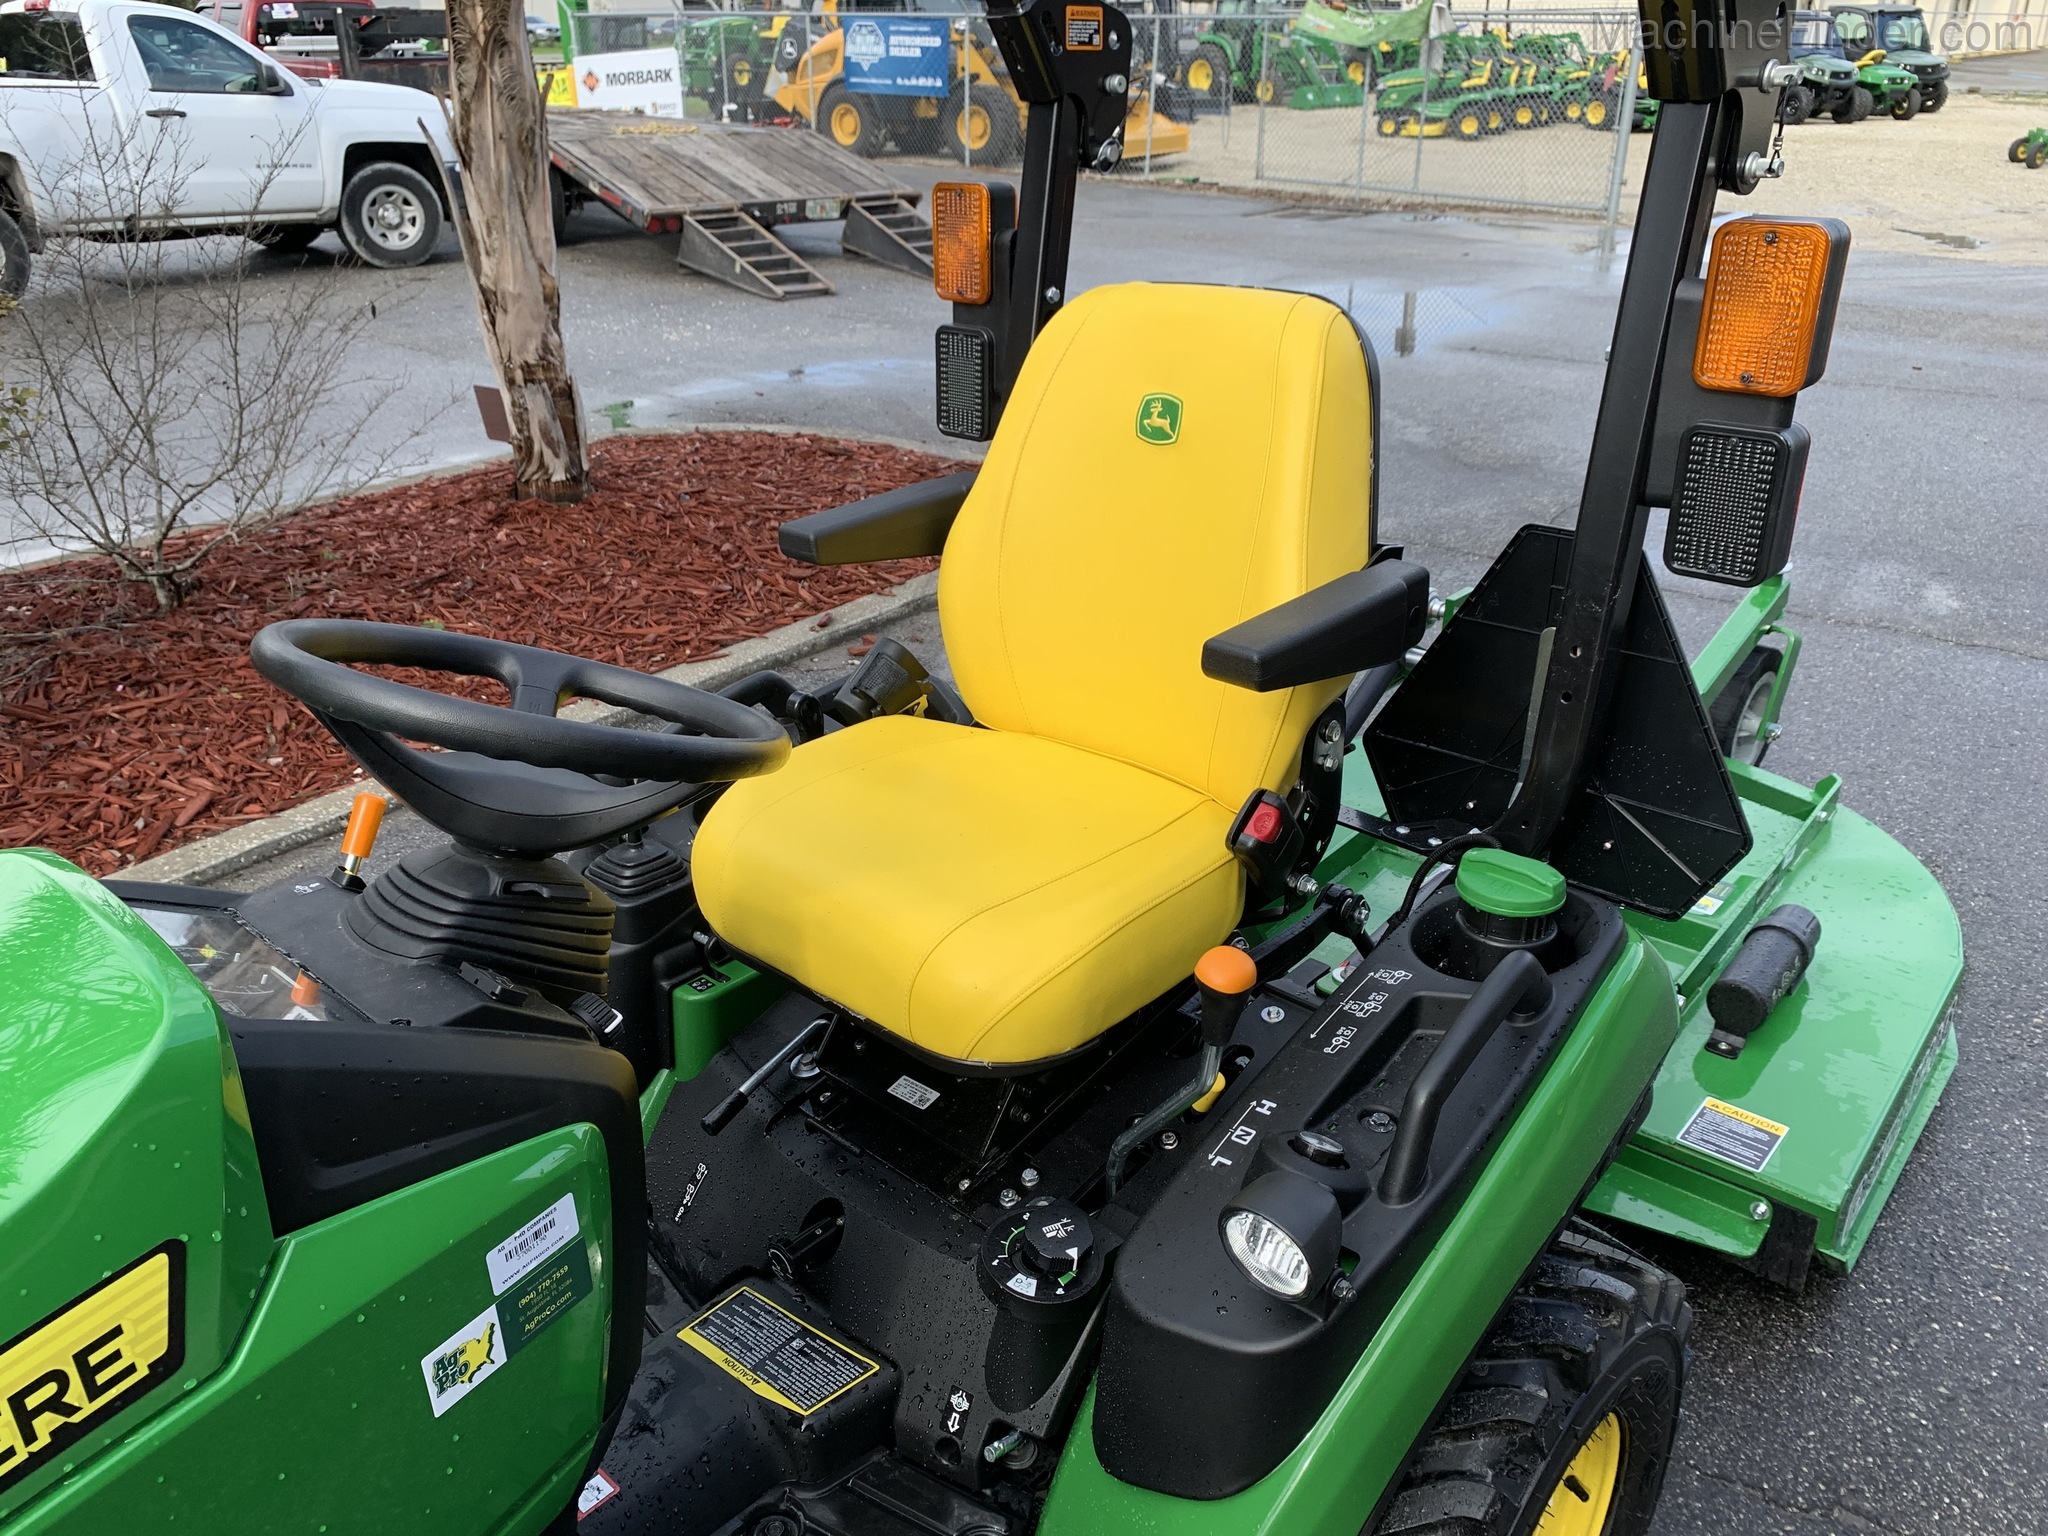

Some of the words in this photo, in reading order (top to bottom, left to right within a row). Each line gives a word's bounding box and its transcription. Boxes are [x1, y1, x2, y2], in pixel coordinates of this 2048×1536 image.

[605, 68, 673, 87] MORBARK
[1255, 1099, 1277, 1116] H
[1721, 1105, 1780, 1132] CAUTION
[1211, 1156, 1233, 1167] L
[497, 1244, 505, 1254] AG
[526, 1205, 557, 1232] COMPANIES
[518, 1289, 536, 1309] (904)
[537, 1263, 568, 1293] 770-7559
[524, 1290, 571, 1334] AgProCo.com
[434, 1347, 466, 1379] Ag-
[720, 1357, 755, 1381] CAUTION
[437, 1361, 470, 1397] Pro
